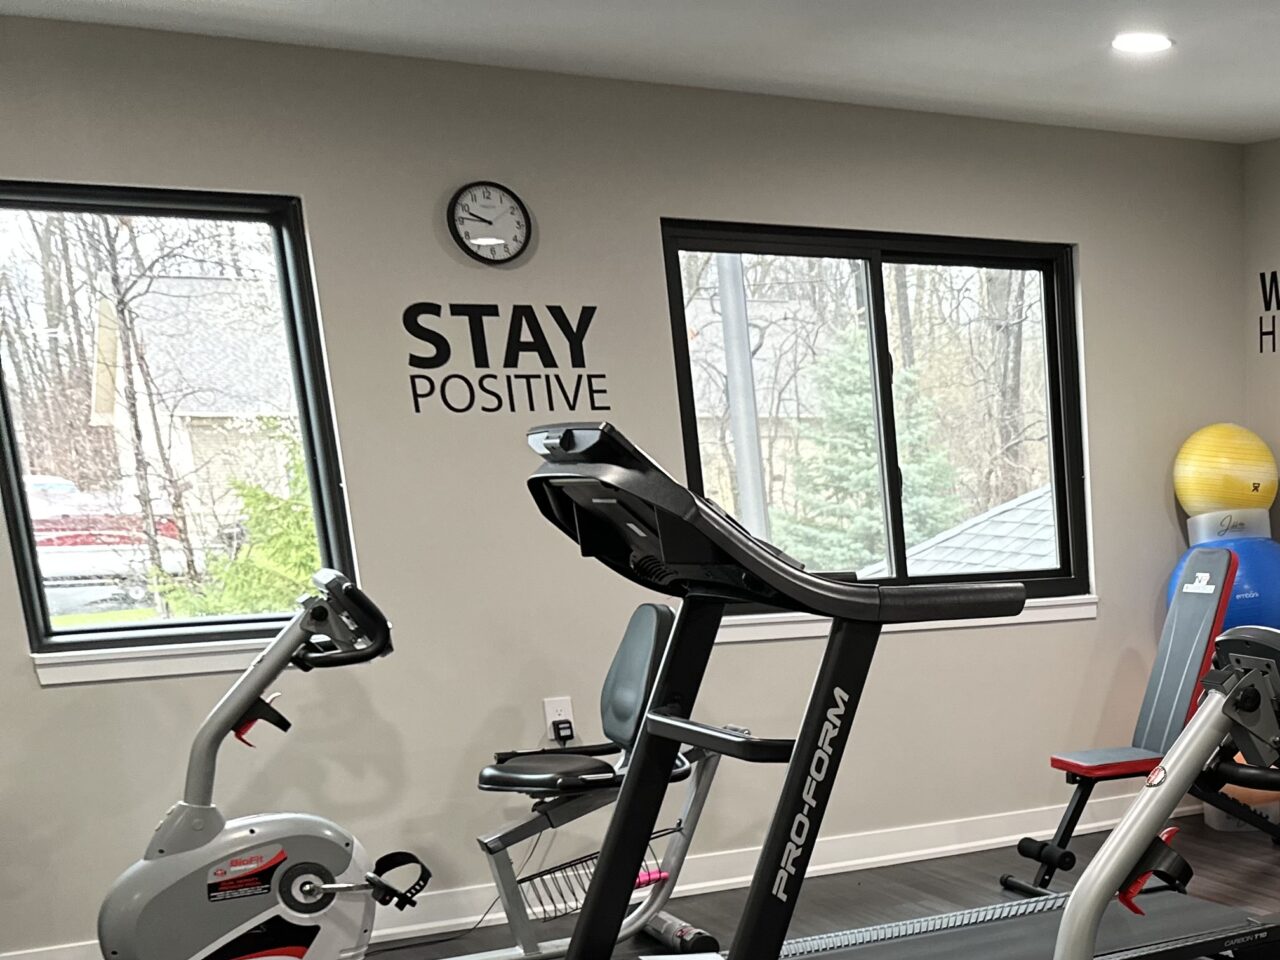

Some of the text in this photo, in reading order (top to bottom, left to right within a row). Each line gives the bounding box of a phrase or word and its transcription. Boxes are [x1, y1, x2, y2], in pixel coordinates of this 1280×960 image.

[402, 302, 597, 369] STAY
[409, 373, 611, 413] POSITIVE
[771, 686, 850, 902] PRO-FORM
